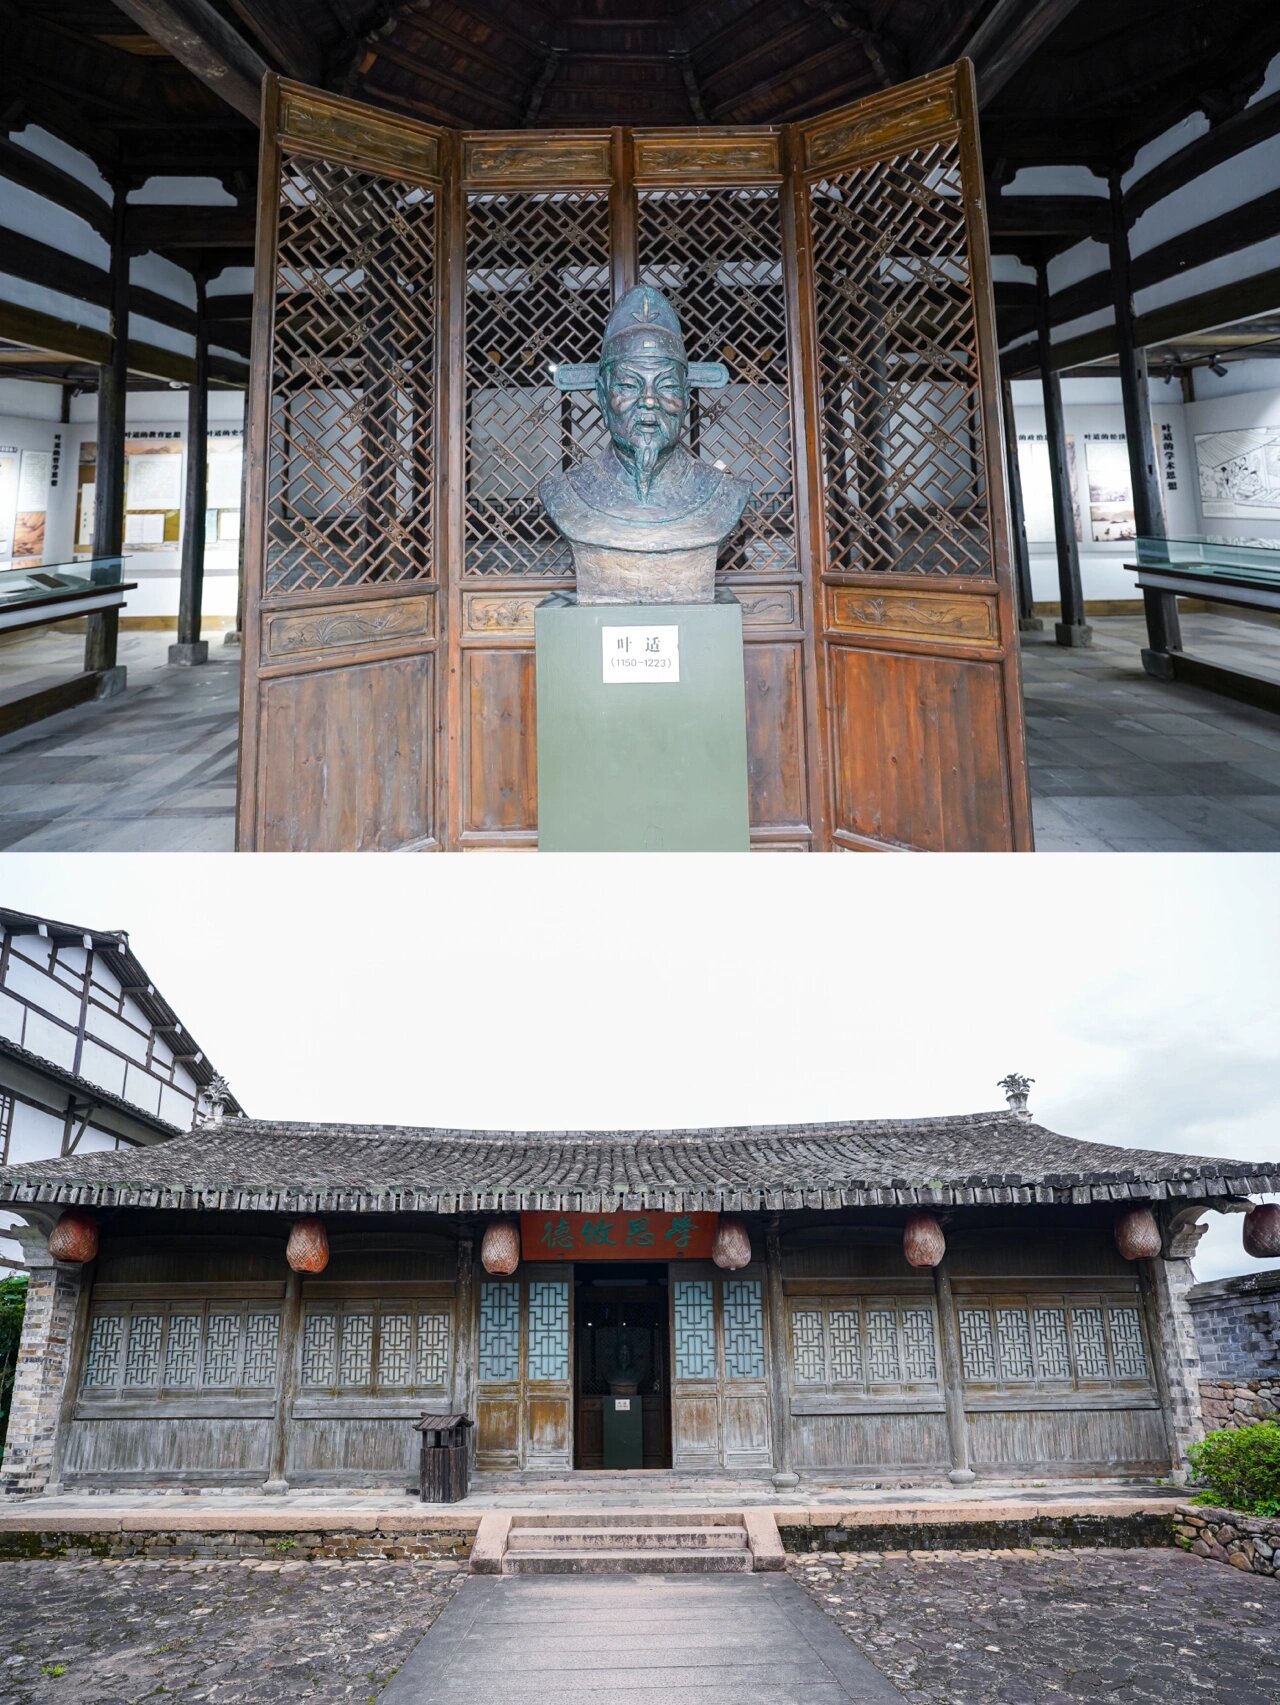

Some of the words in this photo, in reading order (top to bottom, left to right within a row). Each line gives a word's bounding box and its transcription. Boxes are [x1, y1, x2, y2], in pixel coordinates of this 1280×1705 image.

[1161, 423, 1178, 491] 叶适的学术思想
[617, 636, 661, 653] 叶适
[610, 657, 672, 669] (1150-1223)
